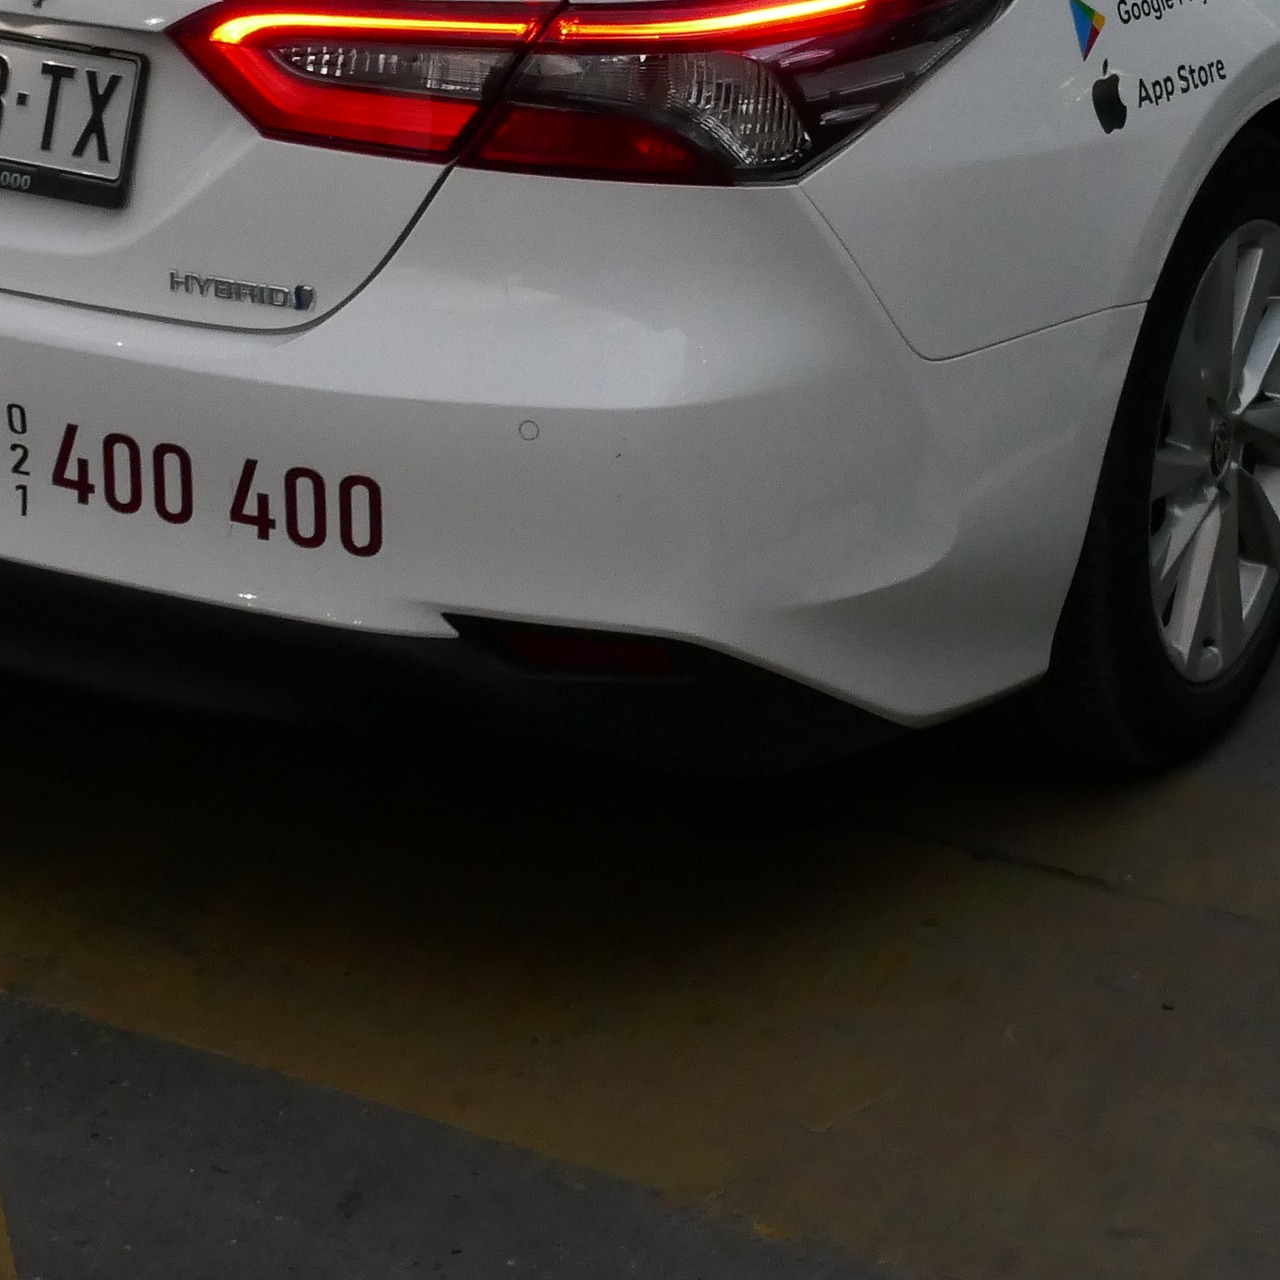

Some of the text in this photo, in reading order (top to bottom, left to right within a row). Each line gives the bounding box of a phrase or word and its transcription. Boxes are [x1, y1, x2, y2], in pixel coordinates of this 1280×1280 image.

[1138, 59, 1227, 109] App Store
[0, 171, 32, 190] 000
[170, 269, 291, 307] HYBRID
[52, 423, 194, 525] 400
[230, 458, 384, 558] 400
